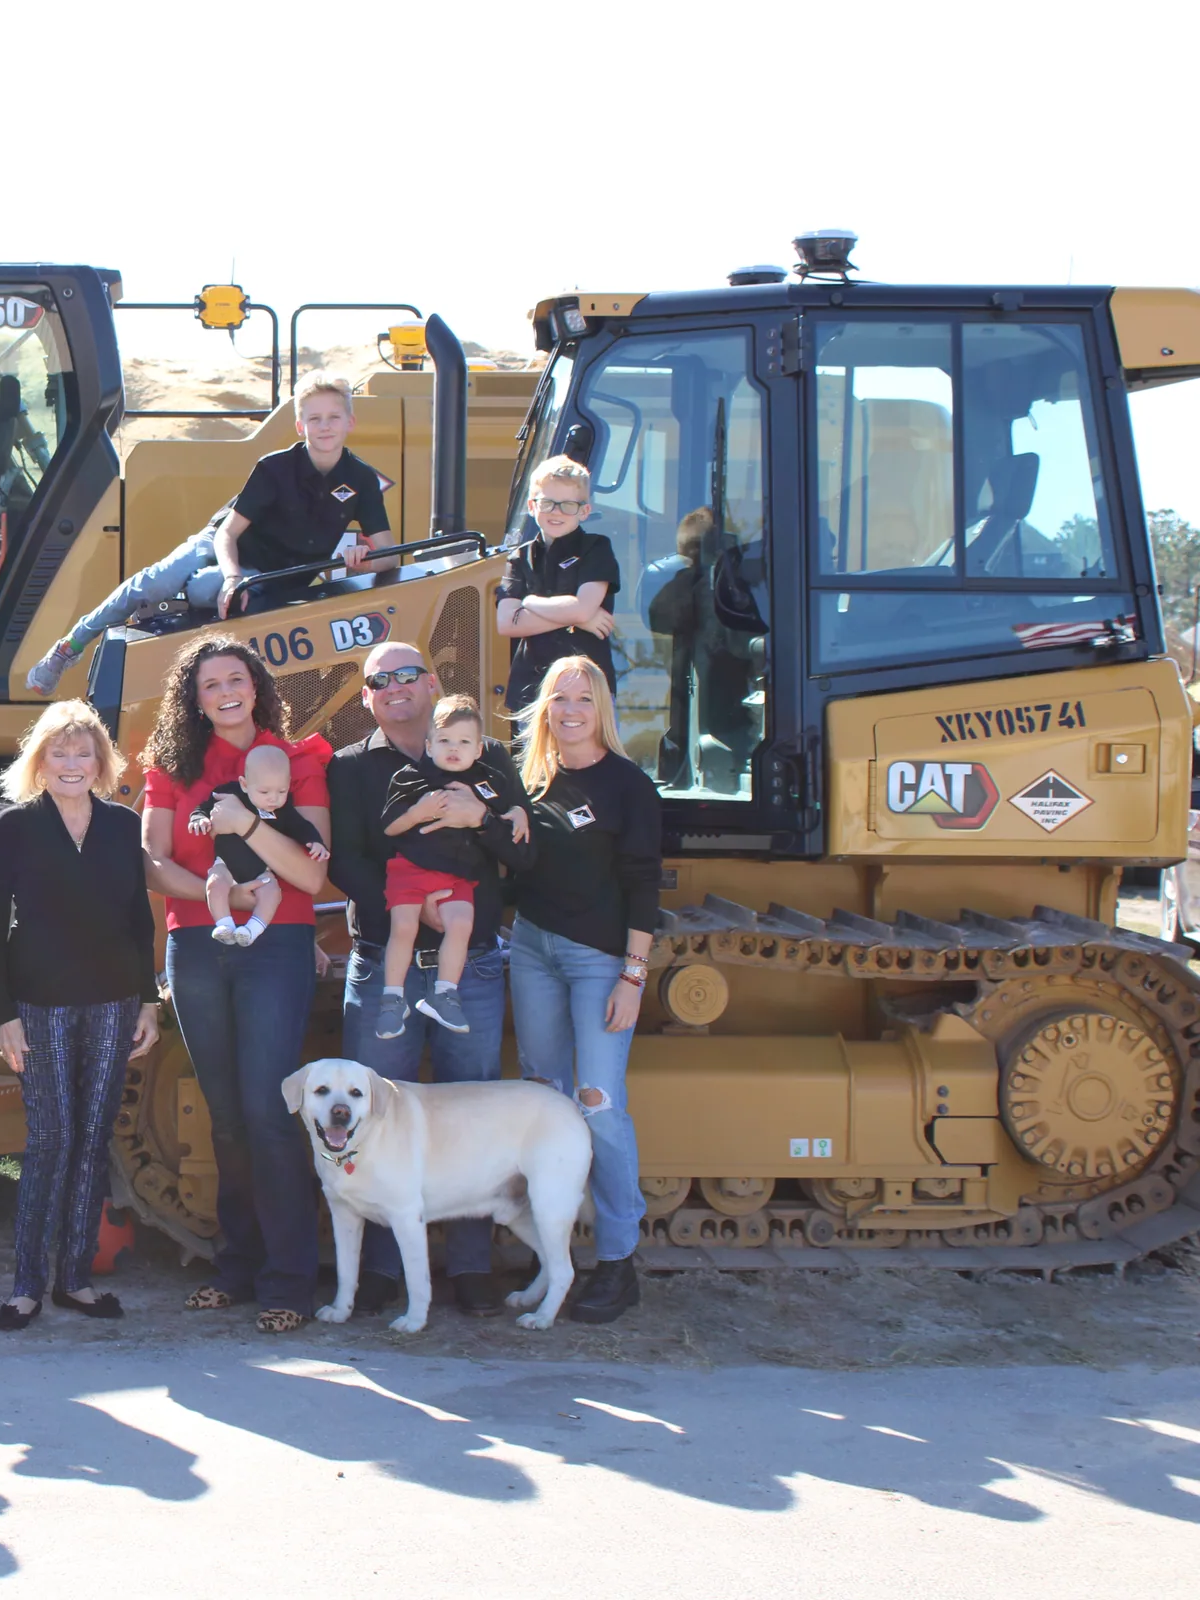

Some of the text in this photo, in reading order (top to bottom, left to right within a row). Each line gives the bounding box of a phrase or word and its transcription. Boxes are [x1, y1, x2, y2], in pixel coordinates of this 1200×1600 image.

[330, 616, 374, 651] D3
[935, 700, 1087, 743] XKY05741
[887, 761, 973, 814] CAT
